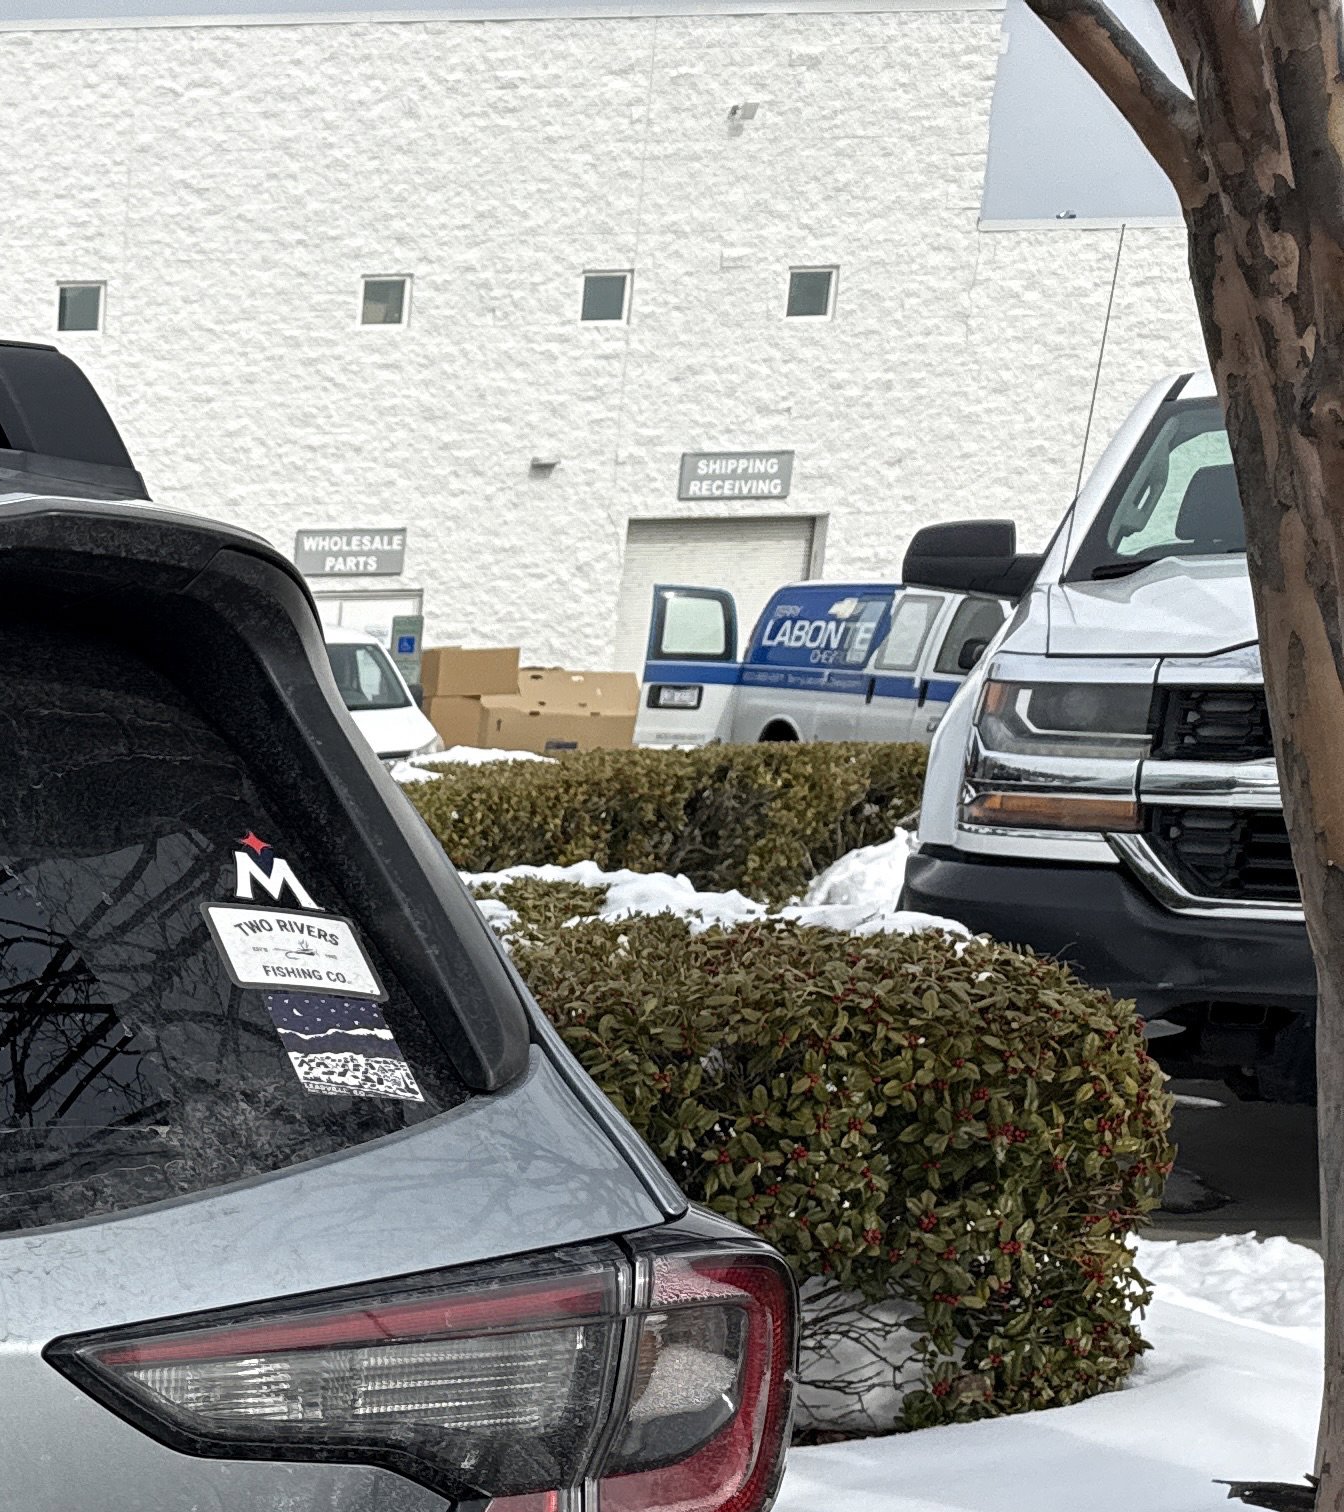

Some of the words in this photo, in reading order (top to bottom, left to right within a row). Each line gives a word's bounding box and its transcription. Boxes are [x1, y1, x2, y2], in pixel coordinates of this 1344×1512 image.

[697, 458, 779, 474] SHIPPING
[689, 479, 782, 495] RECEIVING
[303, 535, 404, 551] WHOLESALE
[324, 556, 378, 571] PARTS
[762, 618, 878, 650] LABONTE
[233, 918, 273, 937] TWO
[275, 918, 340, 946] RIVERS
[262, 965, 323, 981] FISHING
